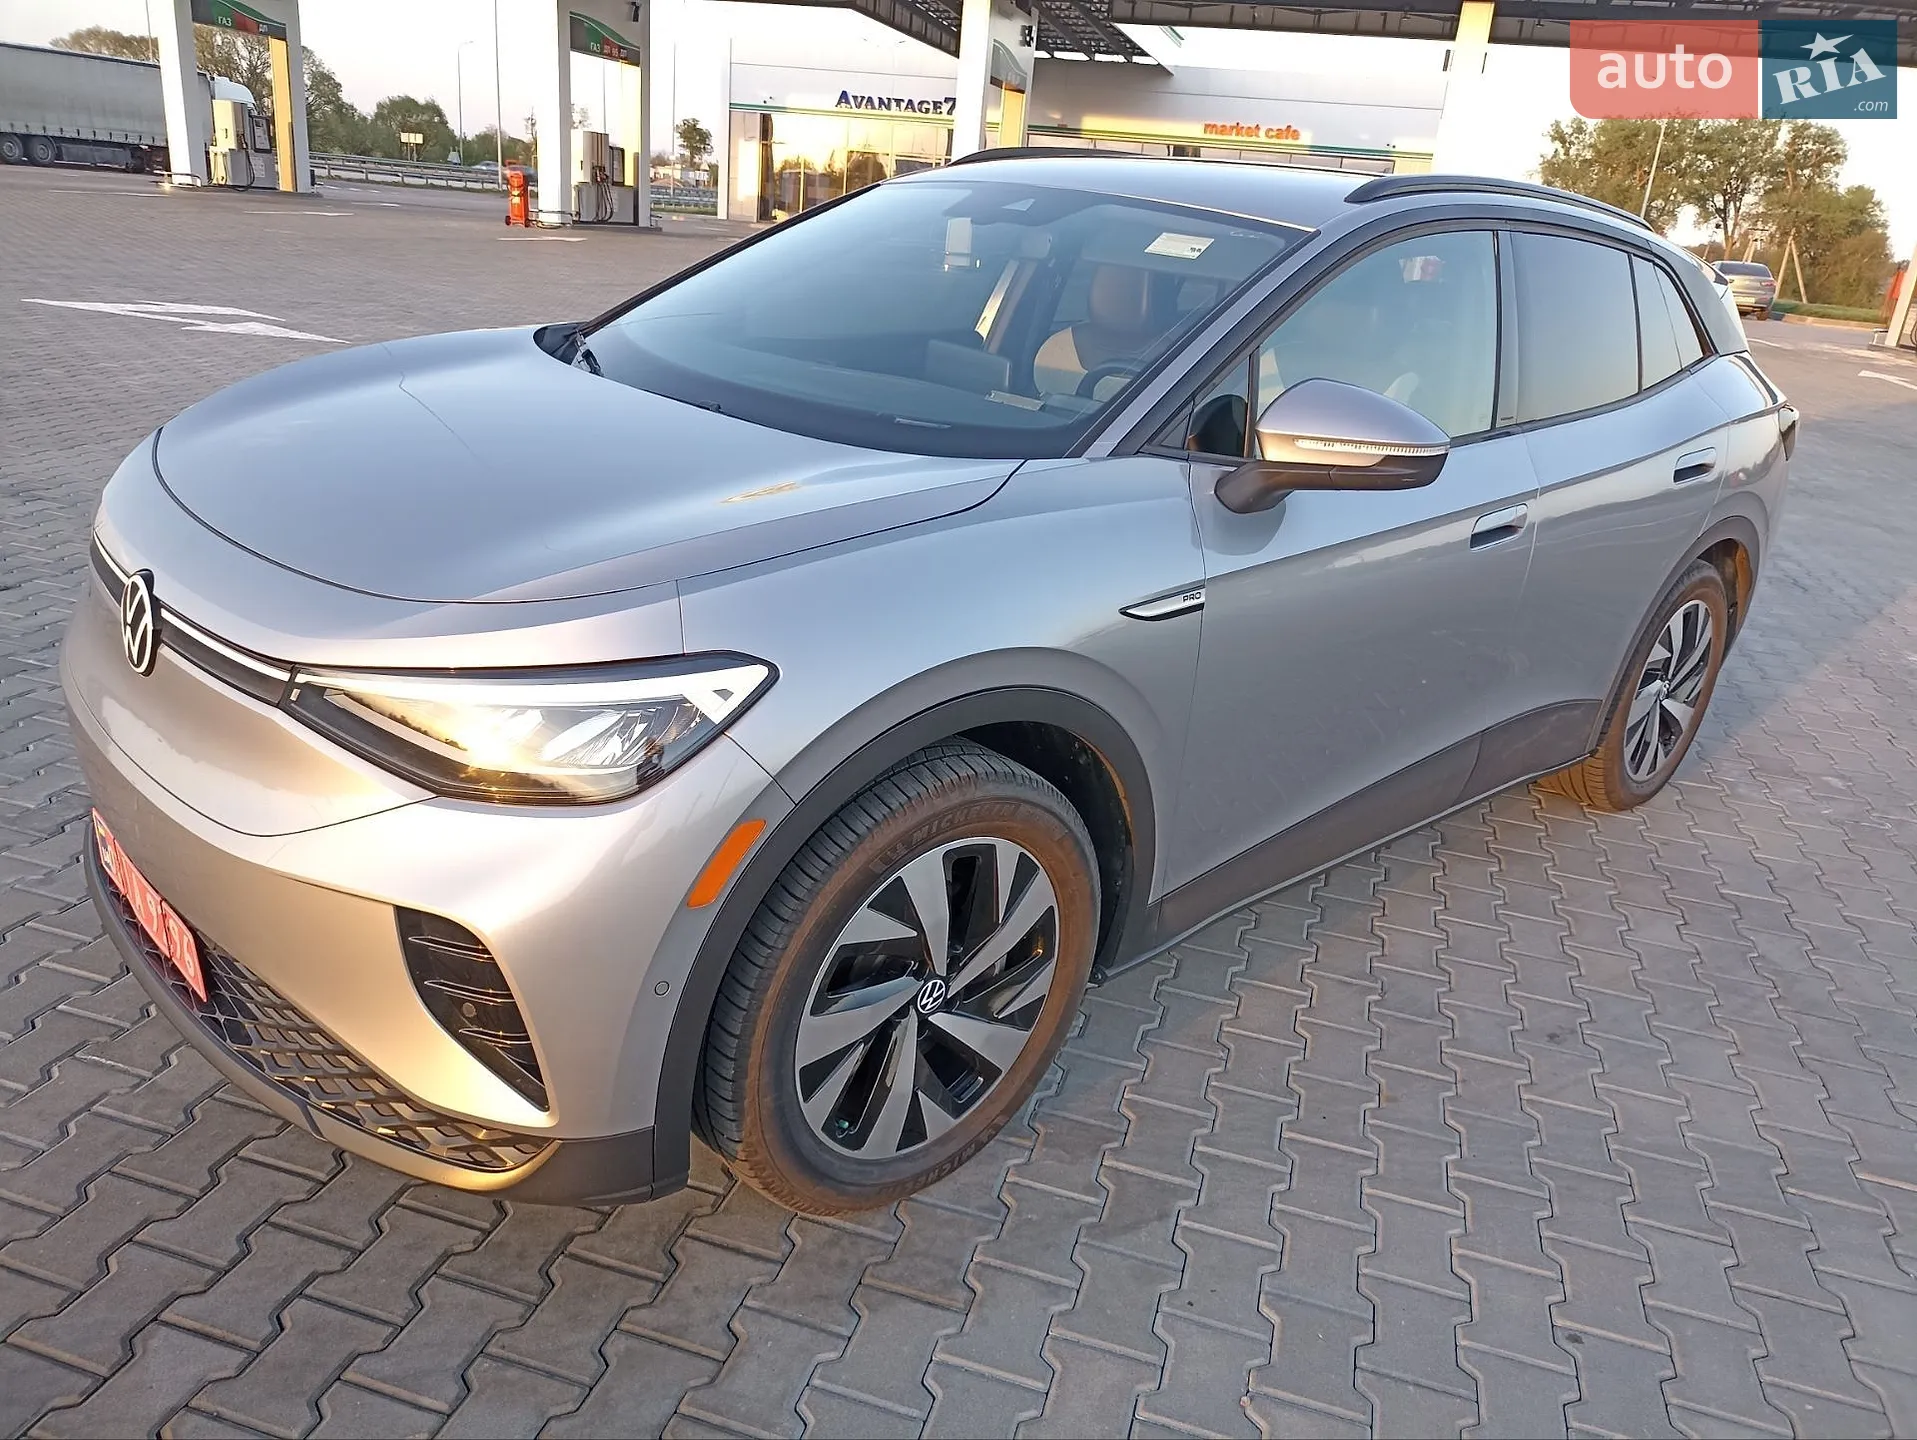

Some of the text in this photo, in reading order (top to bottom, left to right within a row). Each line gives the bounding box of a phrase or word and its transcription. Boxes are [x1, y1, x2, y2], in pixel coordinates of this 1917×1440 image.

[217, 16, 232, 27] ГАЗ
[590, 42, 601, 53] ГАЗ
[1203, 122, 1301, 141] market cafe
[1182, 591, 1202, 603] PRO
